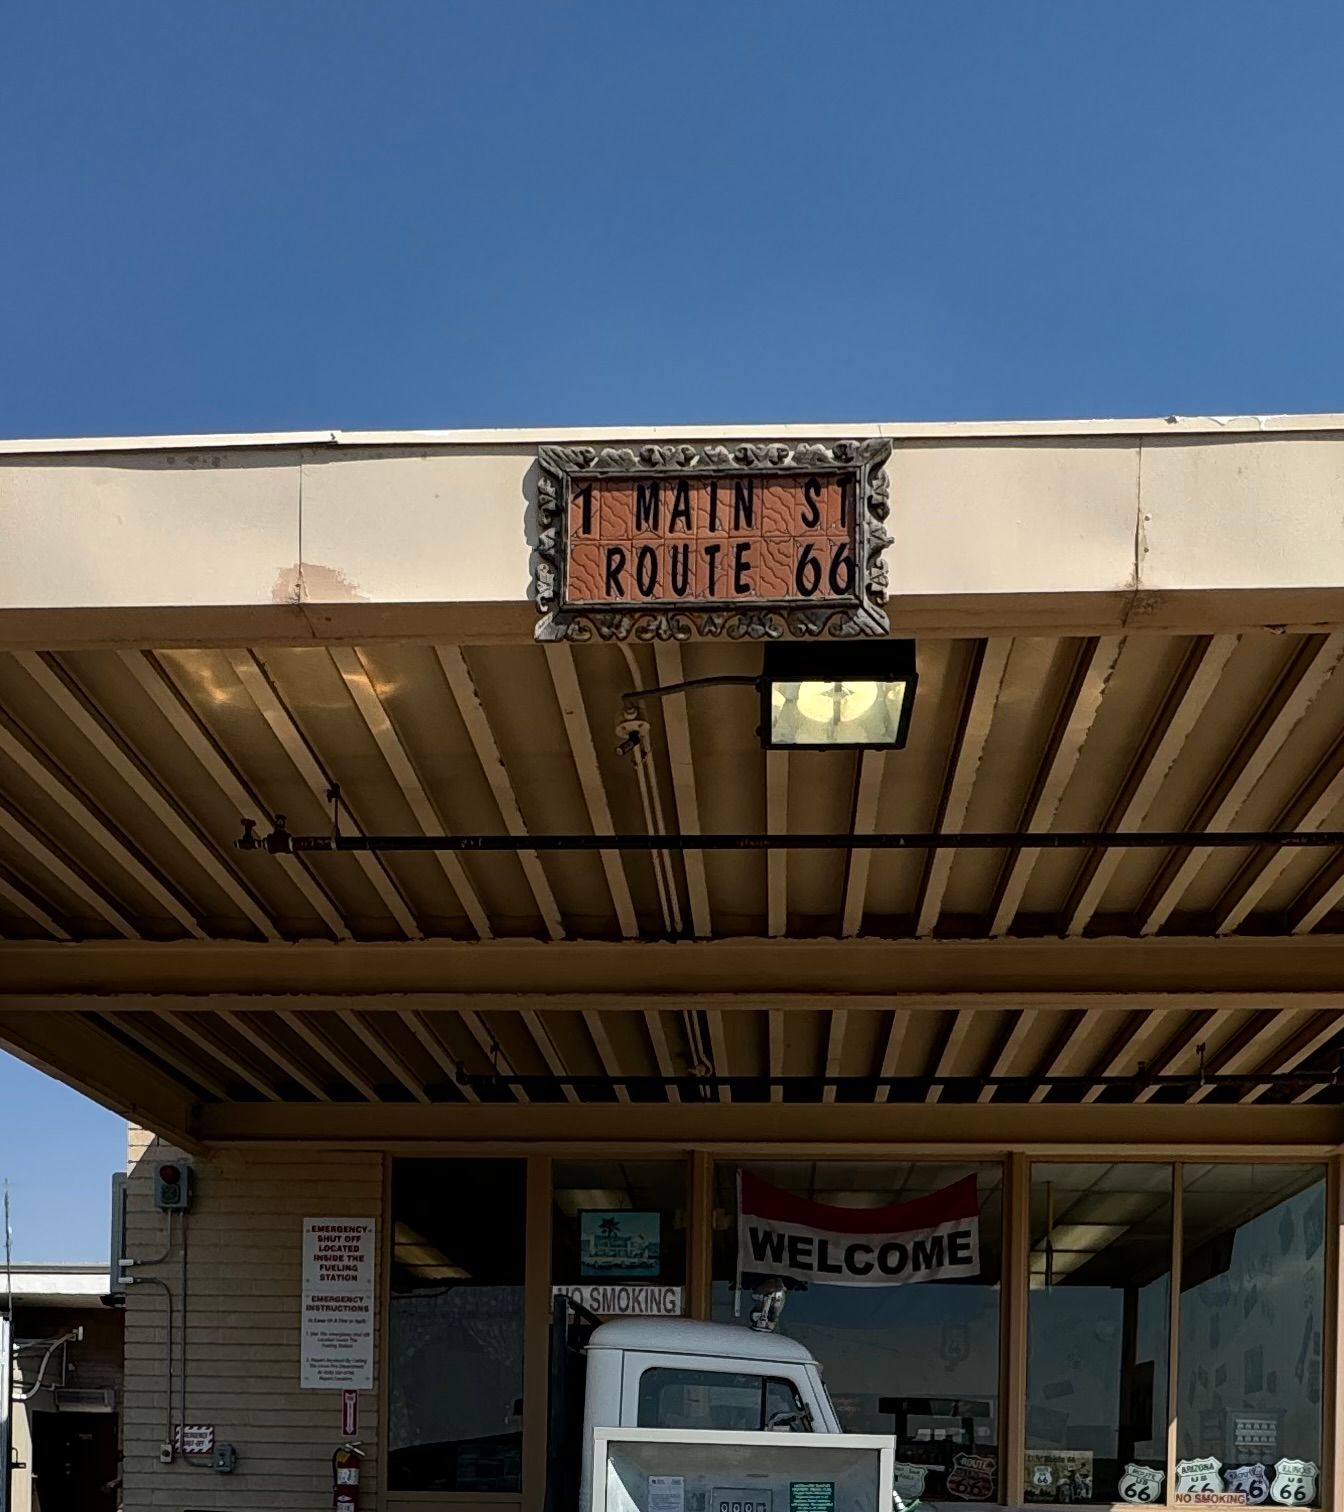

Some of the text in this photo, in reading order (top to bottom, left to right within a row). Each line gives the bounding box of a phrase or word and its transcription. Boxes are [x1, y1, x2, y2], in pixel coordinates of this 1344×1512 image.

[573, 472, 855, 535] 1 MAIN ST
[605, 542, 855, 598] ROUTE 66
[311, 1225, 368, 1233] EMERGENCY
[317, 1235, 362, 1243] SHUT OFF
[748, 1227, 973, 1276] WELCOME
[313, 1254, 345, 1262] INSIDE
[319, 1264, 358, 1272] FUELING
[319, 1273, 358, 1281] STATION
[311, 1295, 364, 1303] EMERGENCY
[589, 1287, 677, 1314] SMOKING
[305, 1304, 369, 1312] INSTRUCTIONS
[1181, 1463, 1215, 1474] ARIZONA
[1124, 1482, 1151, 1502] 66
[1279, 1483, 1306, 1501] 66
[1175, 1493, 1246, 1504] NO SMOKING
